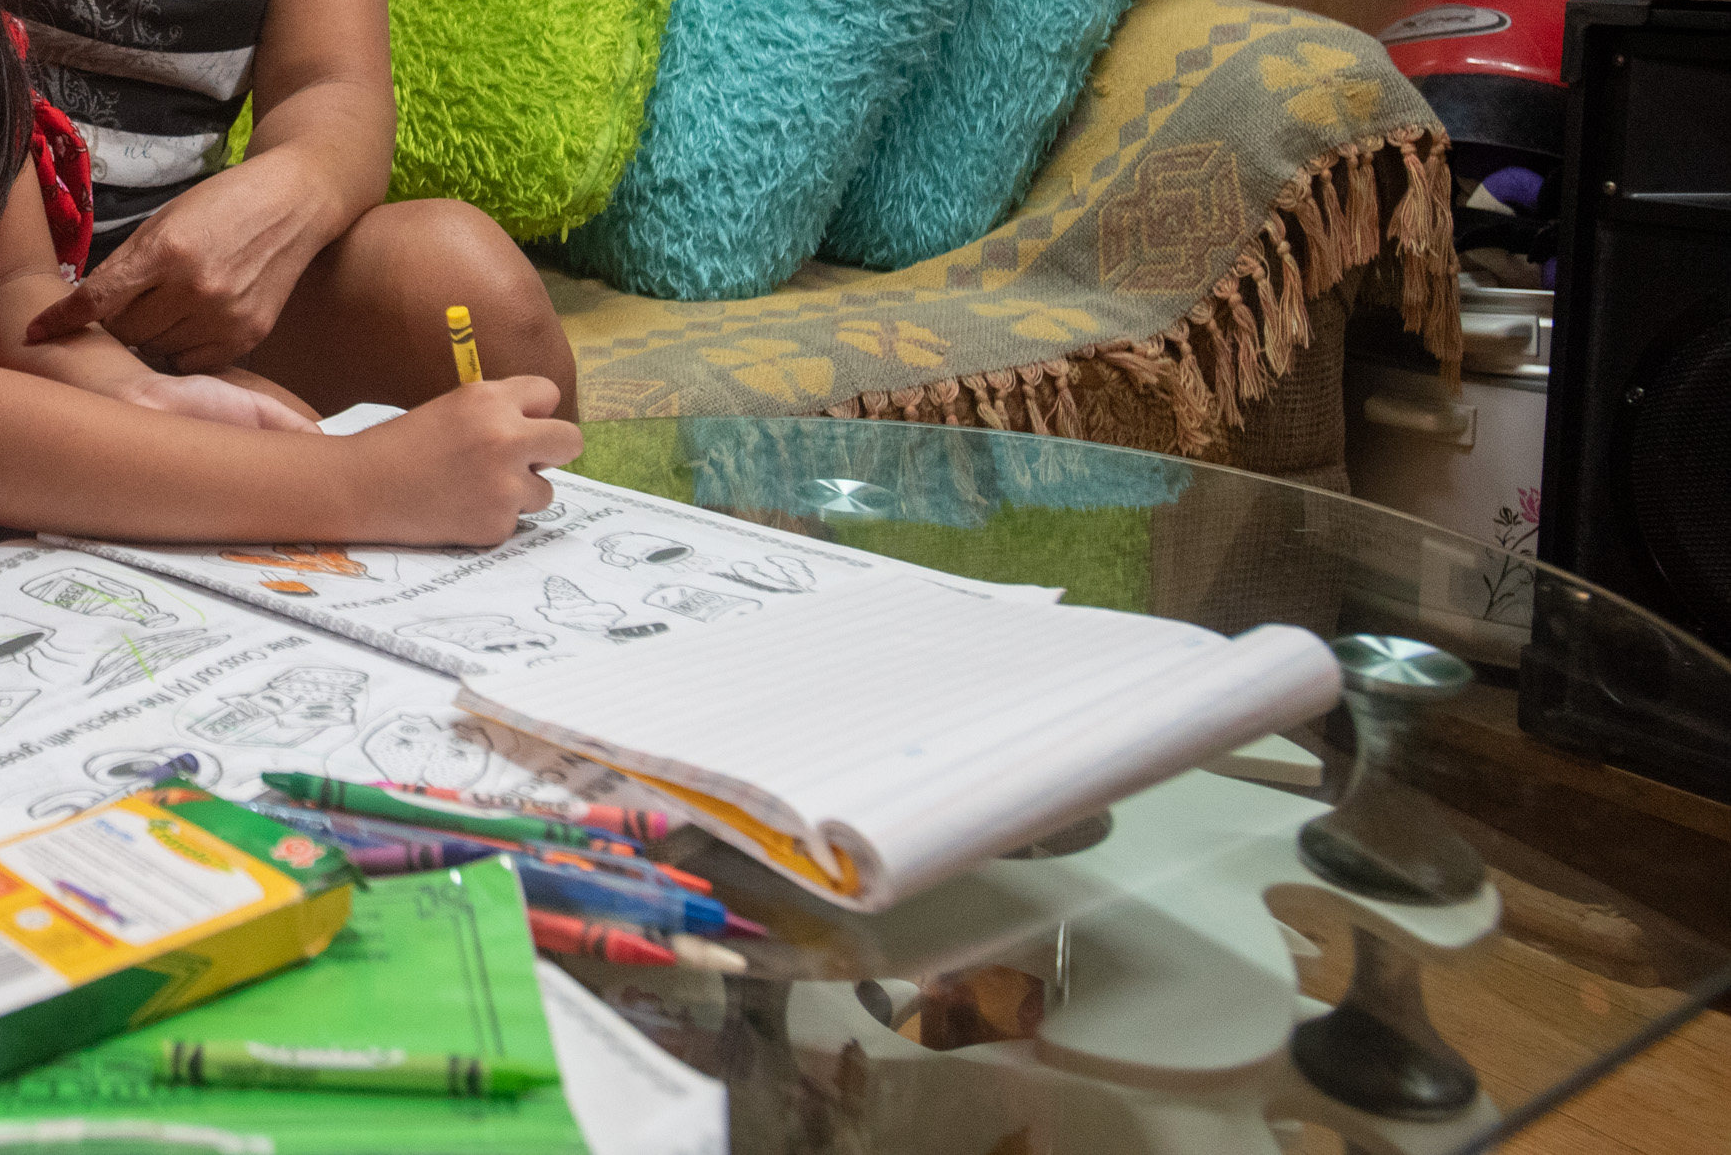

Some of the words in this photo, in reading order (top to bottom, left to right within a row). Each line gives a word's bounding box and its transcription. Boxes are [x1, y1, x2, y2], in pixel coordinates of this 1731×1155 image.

[492, 548, 529, 562] the
[431, 558, 495, 586] objects
[396, 583, 439, 601] that
[221, 650, 268, 669] Cross
[191, 666, 223, 685] out
[138, 693, 176, 708] the
[76, 705, 142, 732] objects
[39, 728, 79, 747] with
